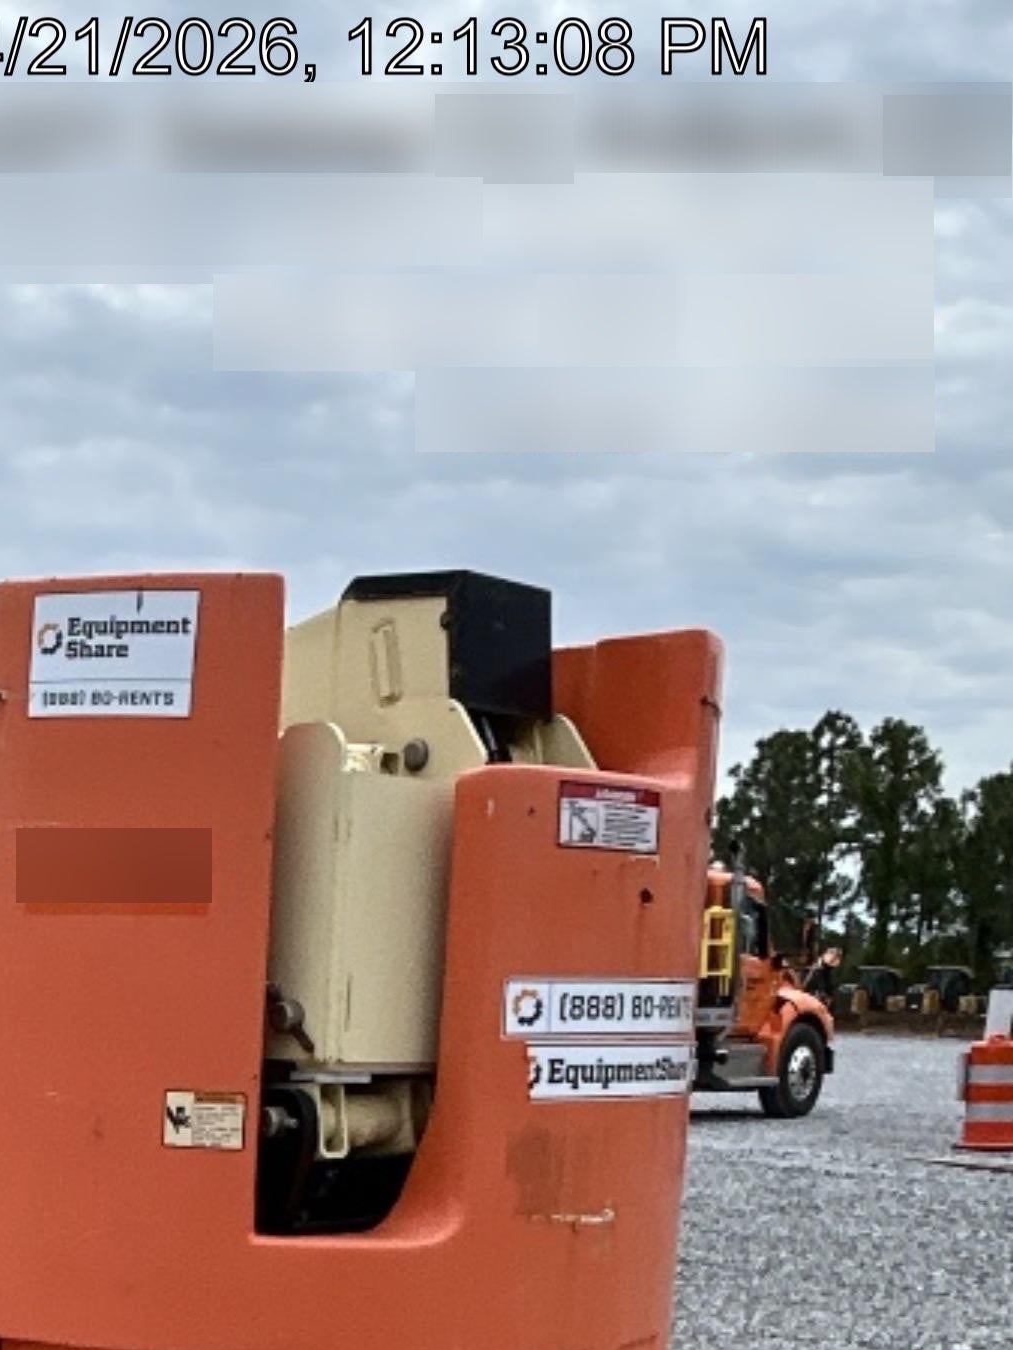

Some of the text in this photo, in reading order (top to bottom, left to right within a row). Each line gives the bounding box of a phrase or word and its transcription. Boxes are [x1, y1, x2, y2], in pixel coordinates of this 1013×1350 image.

[67, 615, 191, 639] Equipment
[65, 640, 129, 659] Share
[559, 991, 625, 1022] (888)
